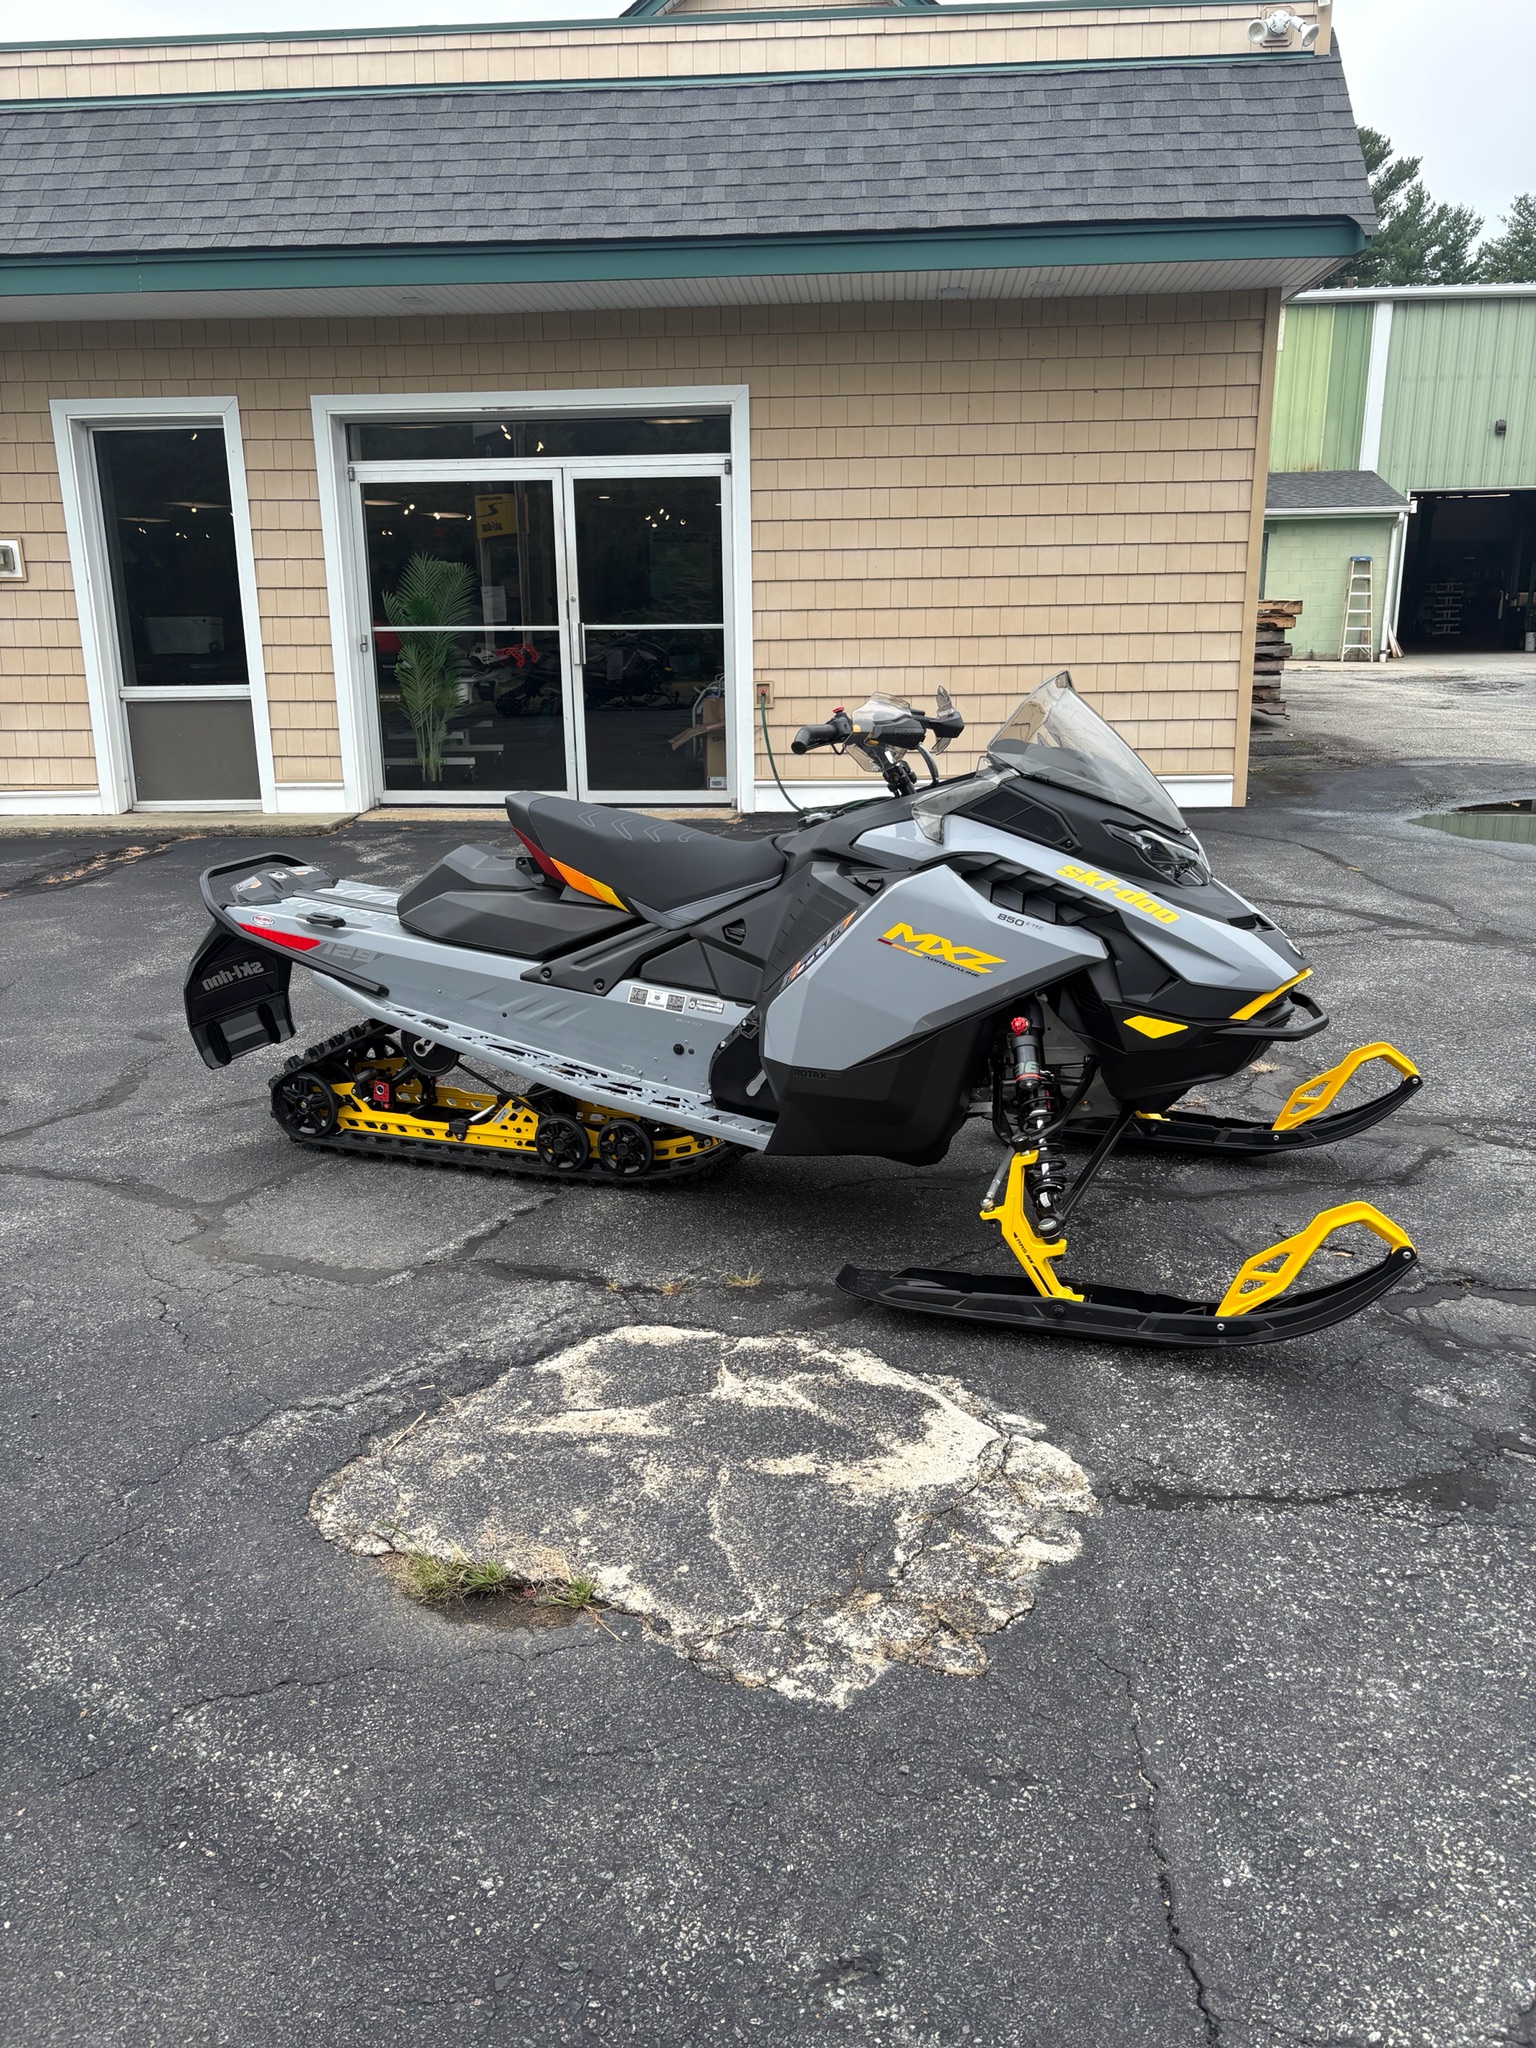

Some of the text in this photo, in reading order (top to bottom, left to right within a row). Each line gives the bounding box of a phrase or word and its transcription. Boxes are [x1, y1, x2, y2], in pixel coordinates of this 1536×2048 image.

[1056, 864, 1180, 924] ski-doo
[997, 913, 1025, 927] 850
[882, 922, 1007, 974] MXZ
[924, 956, 981, 978] ADRENALINE
[793, 1069, 827, 1079] ROTAX
